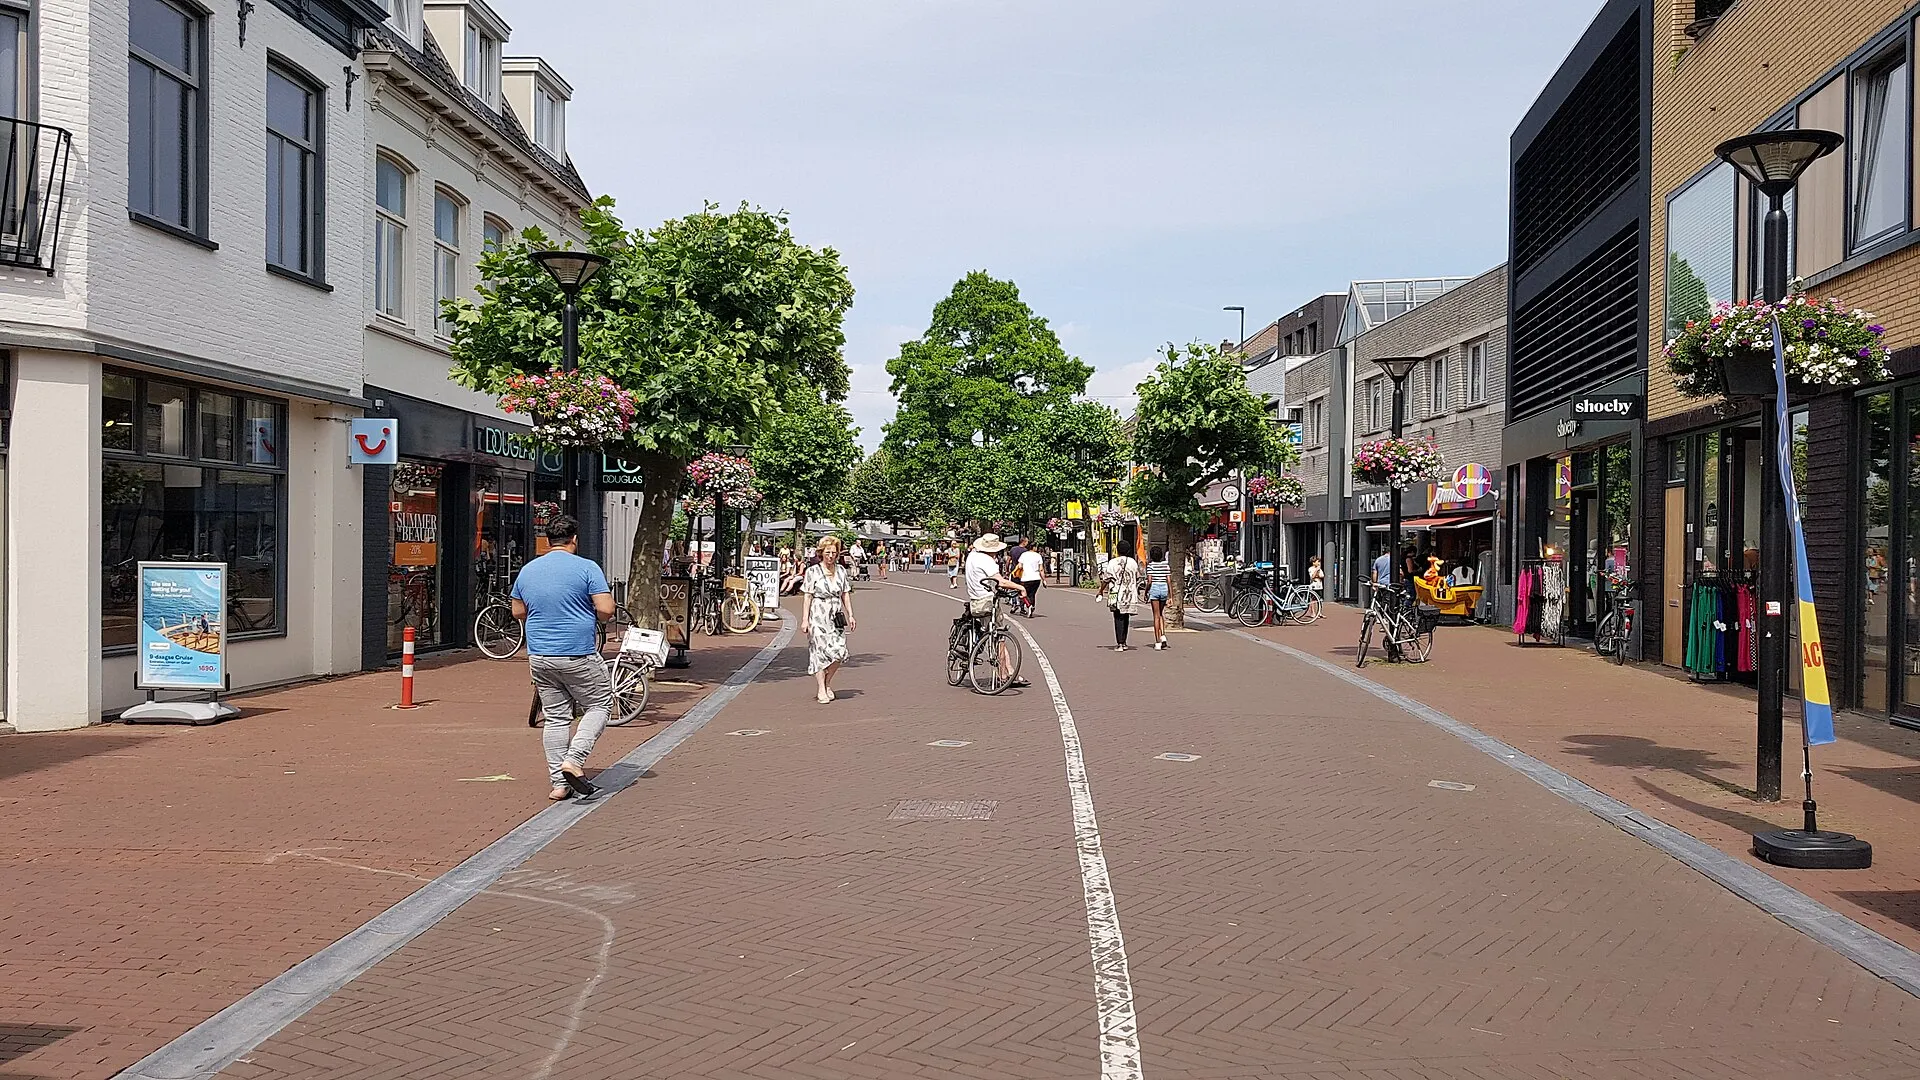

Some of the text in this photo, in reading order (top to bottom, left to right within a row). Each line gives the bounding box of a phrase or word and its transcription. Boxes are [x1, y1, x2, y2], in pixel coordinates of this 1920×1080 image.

[1575, 398, 1633, 416] shoeby
[485, 426, 536, 461] DOUGL
[602, 474, 643, 484] DOUGLAS
[395, 512, 437, 530] SUMMER
[1803, 641, 1823, 668] AC
